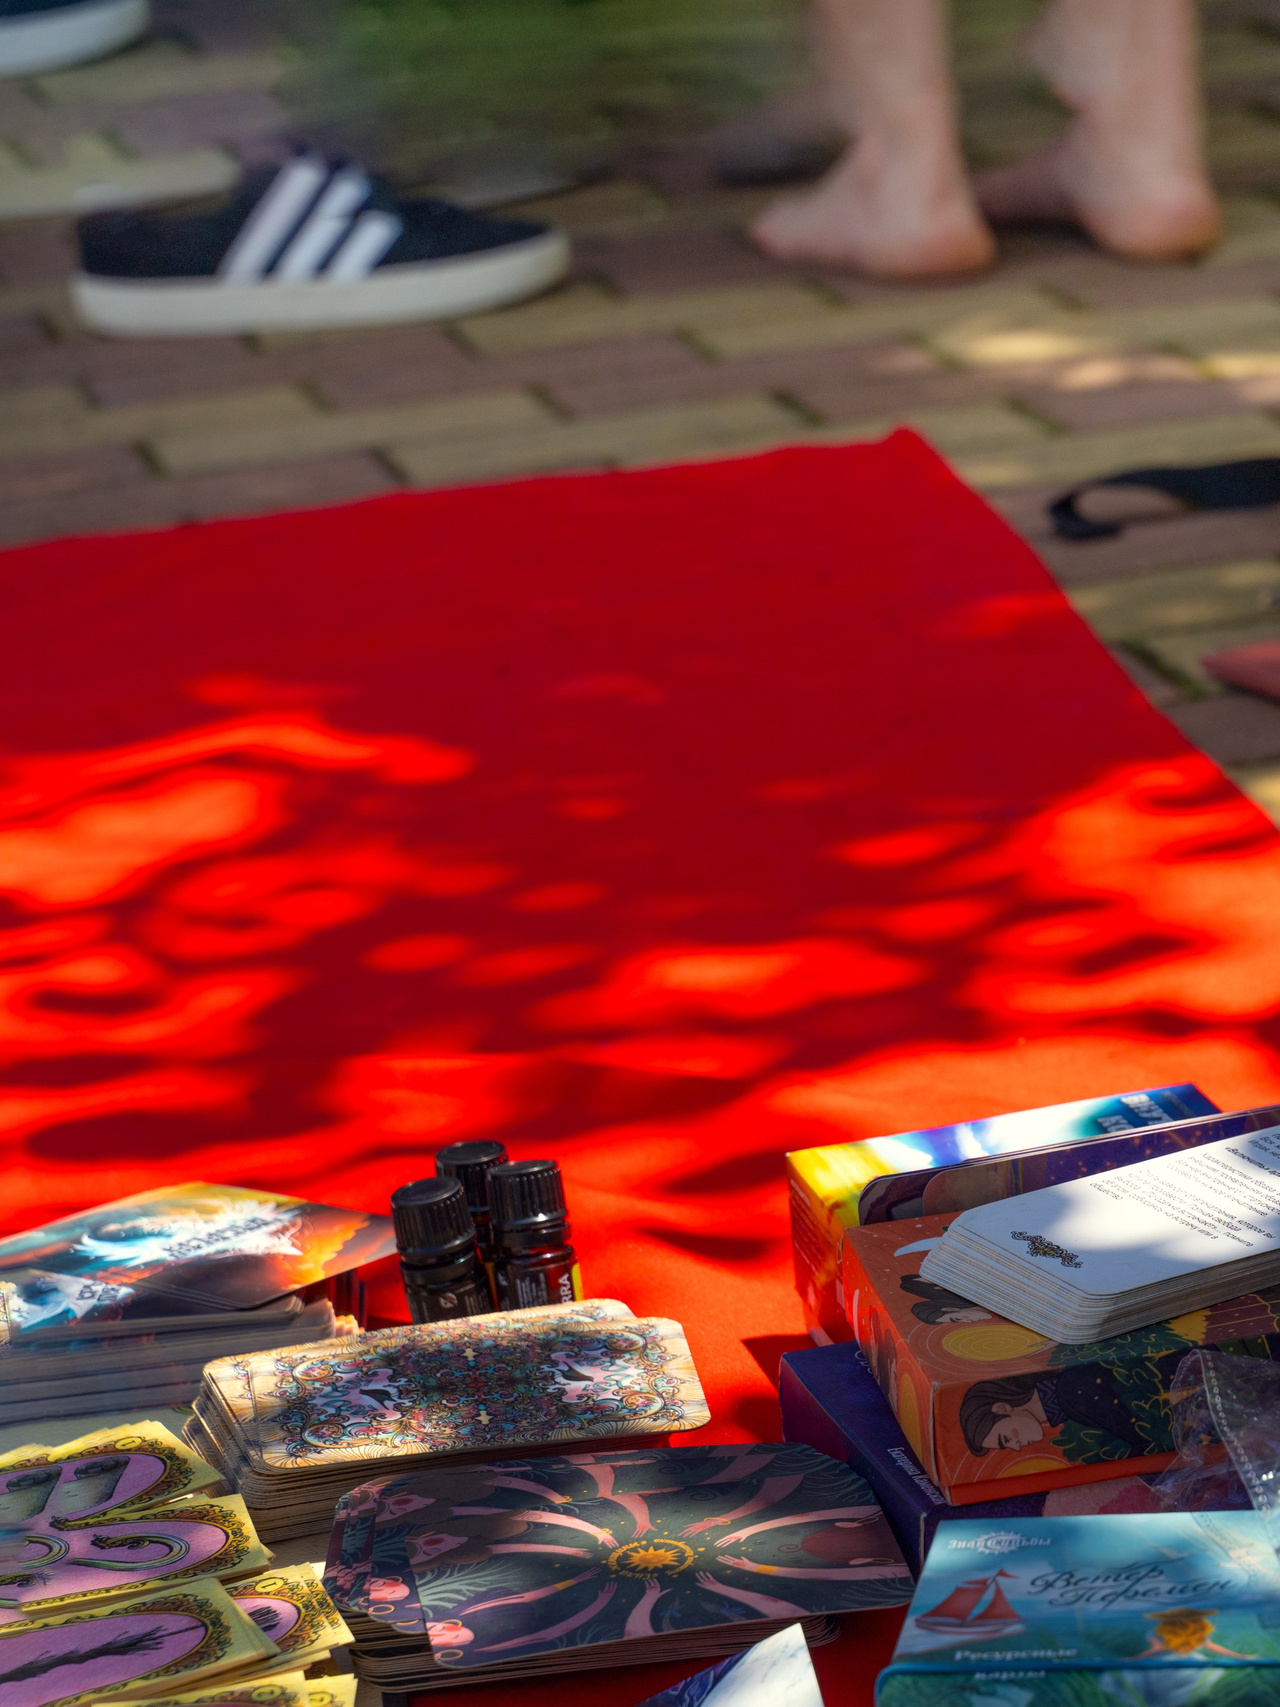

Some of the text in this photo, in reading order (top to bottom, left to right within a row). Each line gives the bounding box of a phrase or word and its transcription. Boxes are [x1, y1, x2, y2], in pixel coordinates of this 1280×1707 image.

[1259, 1136, 1276, 1145] Вся
[1236, 1219, 1266, 1234] которое
[1222, 1231, 1254, 1248] помните
[1028, 1560, 1164, 1605] Ветер
[1049, 1578, 1233, 1610] Перемен
